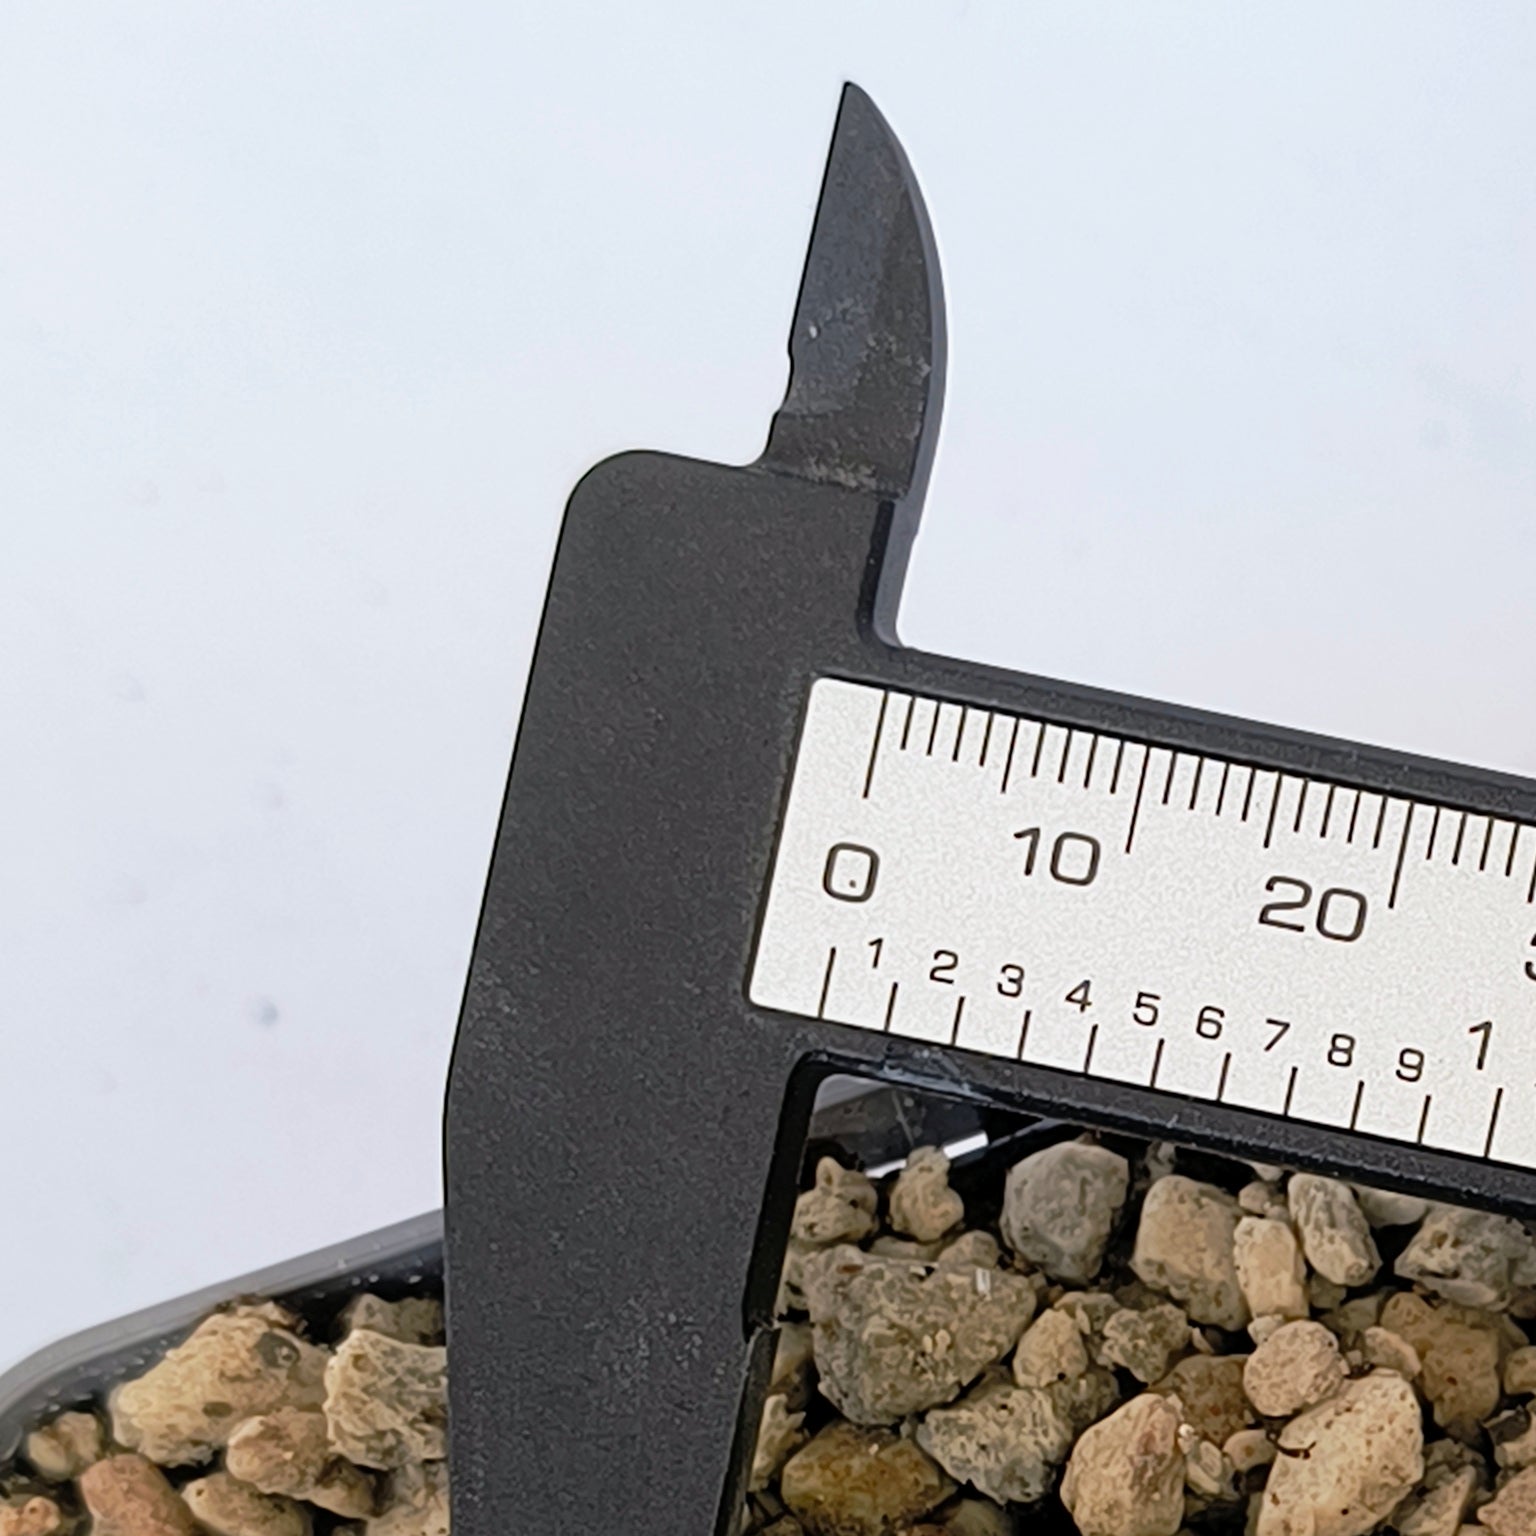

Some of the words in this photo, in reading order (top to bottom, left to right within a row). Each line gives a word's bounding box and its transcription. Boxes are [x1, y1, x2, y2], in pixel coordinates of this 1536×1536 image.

[823, 843, 879, 902] 0
[1014, 828, 1100, 886] 10
[1259, 876, 1367, 942] 20
[869, 938, 883, 968] 1
[930, 950, 958, 984] 2
[997, 964, 1024, 997] 3
[1065, 980, 1092, 1012] 4
[1133, 992, 1160, 1026] 5
[1196, 1006, 1224, 1039] 6
[1264, 1019, 1290, 1051] 7
[1328, 1034, 1355, 1067] 8
[1396, 1048, 1424, 1082] 9
[1469, 1021, 1492, 1070] 1
